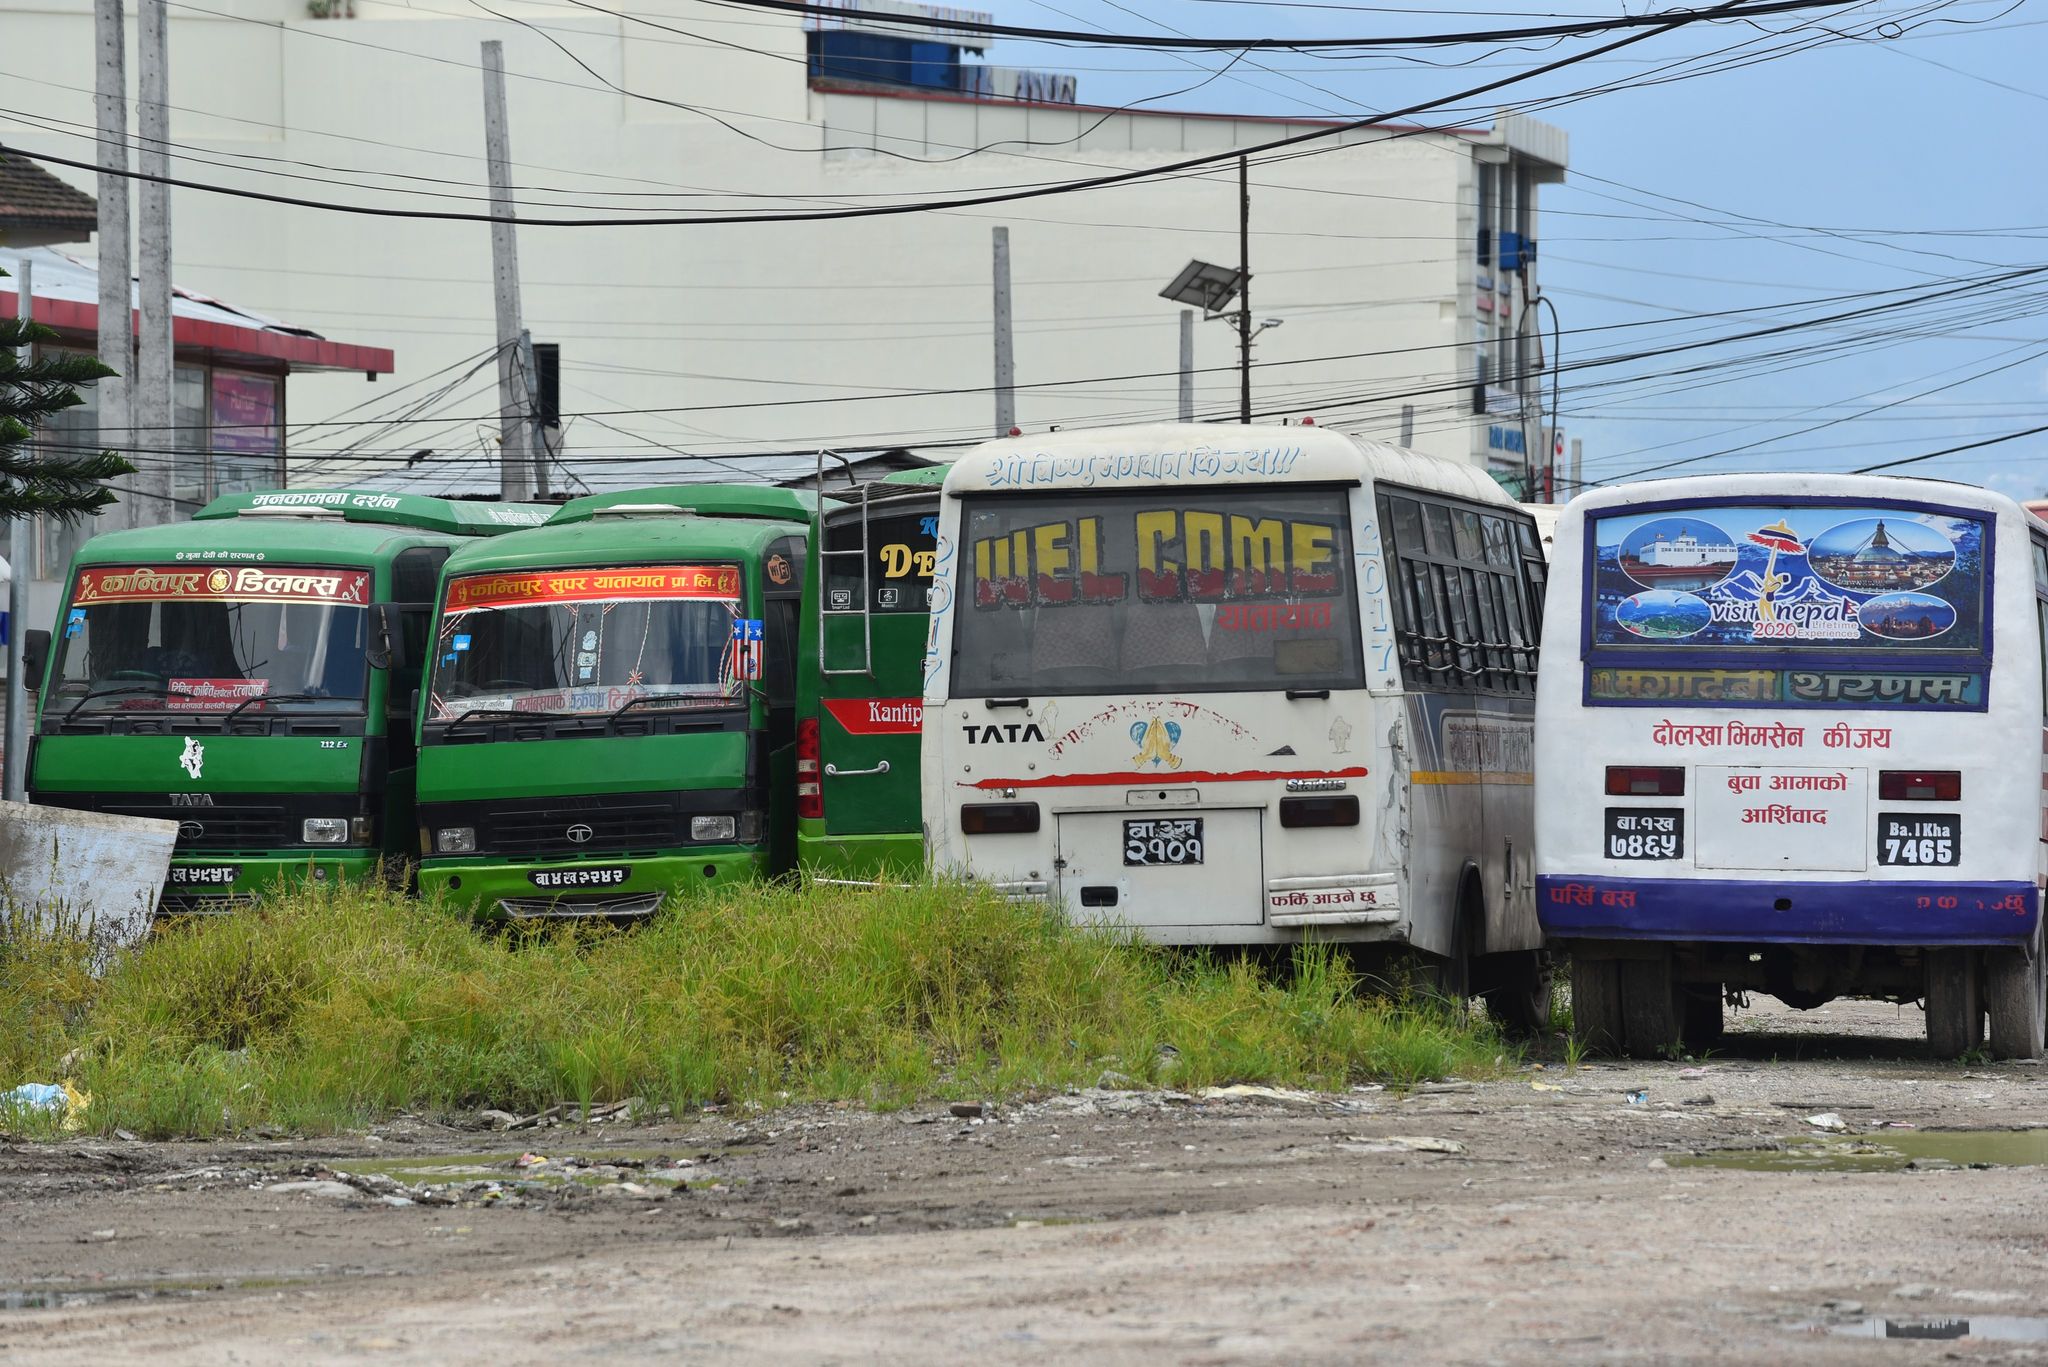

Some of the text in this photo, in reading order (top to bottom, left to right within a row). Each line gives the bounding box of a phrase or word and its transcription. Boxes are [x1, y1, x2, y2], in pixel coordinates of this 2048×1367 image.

[252, 493, 402, 509] मनकामना दर्शन
[217, 551, 228, 560] की
[234, 568, 343, 596] डिलक्स
[549, 577, 588, 594] सुपर
[594, 575, 666, 589] यातायात
[694, 574, 715, 587] लि.
[1216, 601, 1332, 633] यातायात
[1813, 620, 1858, 629] Lifetime
[1754, 622, 1797, 637] 2020
[1798, 629, 1860, 638] Experiences
[963, 724, 1045, 744] TATA
[1652, 719, 1723, 746] दोलखा
[1727, 720, 1805, 748] भिमसेन
[1286, 779, 1347, 792] Starbus
[1728, 772, 1847, 794] बुवा आमाको
[169, 793, 214, 806] TATA
[1611, 834, 1677, 857] ७४६५
[1885, 839, 1952, 863] 7465
[1312, 889, 1355, 904] आउने
[1360, 890, 1377, 904] छु
[1601, 890, 1637, 908] बस
